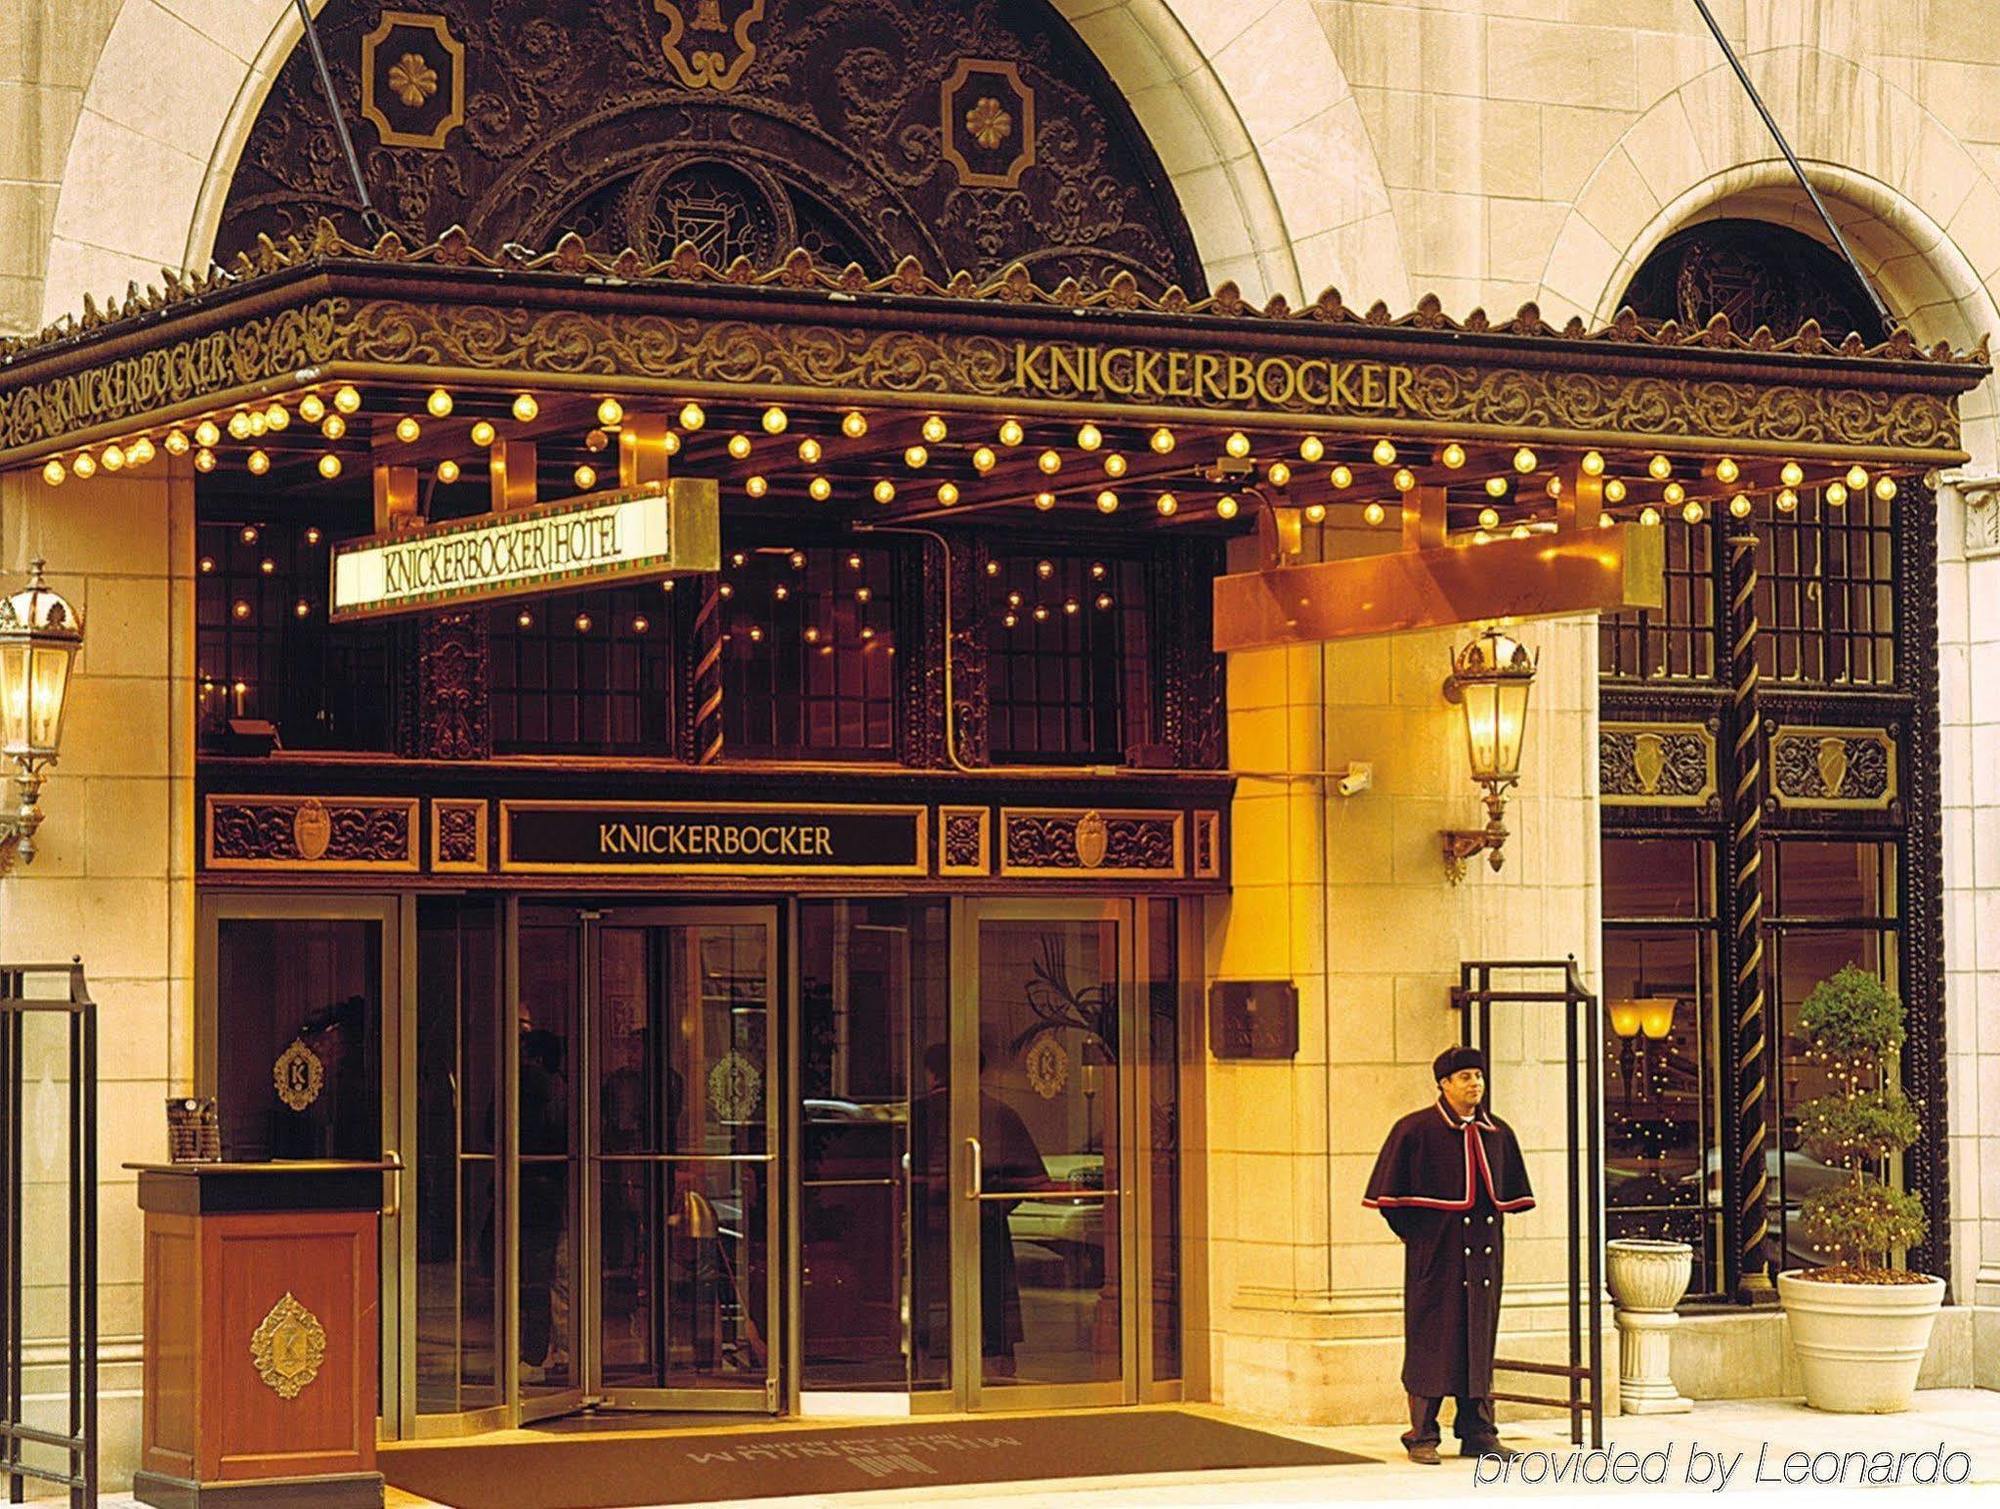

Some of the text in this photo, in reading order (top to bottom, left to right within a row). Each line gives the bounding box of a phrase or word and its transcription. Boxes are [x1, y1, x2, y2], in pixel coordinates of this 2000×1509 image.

[58, 335, 227, 423] KNICKERBOCKER
[1014, 343, 1419, 411] KNICKERBOCKER
[384, 515, 622, 593] KNICKERBOCKER HOTEL
[599, 823, 834, 856] KNICKERBOCKER
